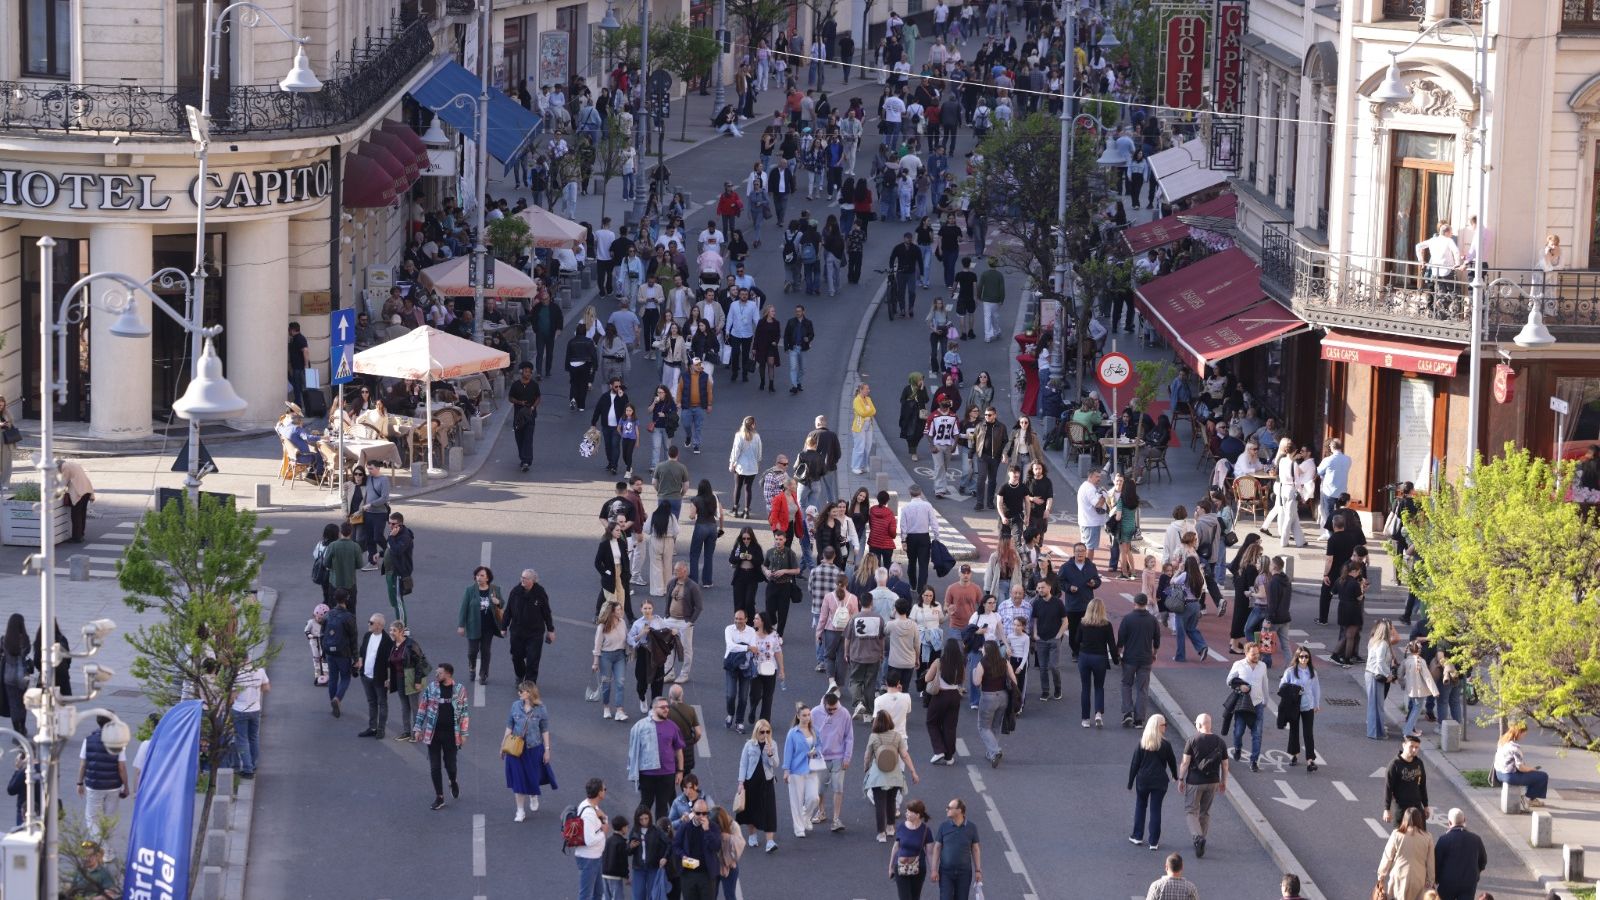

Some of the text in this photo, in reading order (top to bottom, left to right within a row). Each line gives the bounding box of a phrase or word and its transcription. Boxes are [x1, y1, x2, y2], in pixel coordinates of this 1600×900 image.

[1177, 17, 1195, 110] HOTEL
[1222, 9, 1240, 113] CAPȘA
[0, 161, 332, 211] HOTEL CAPITOL
